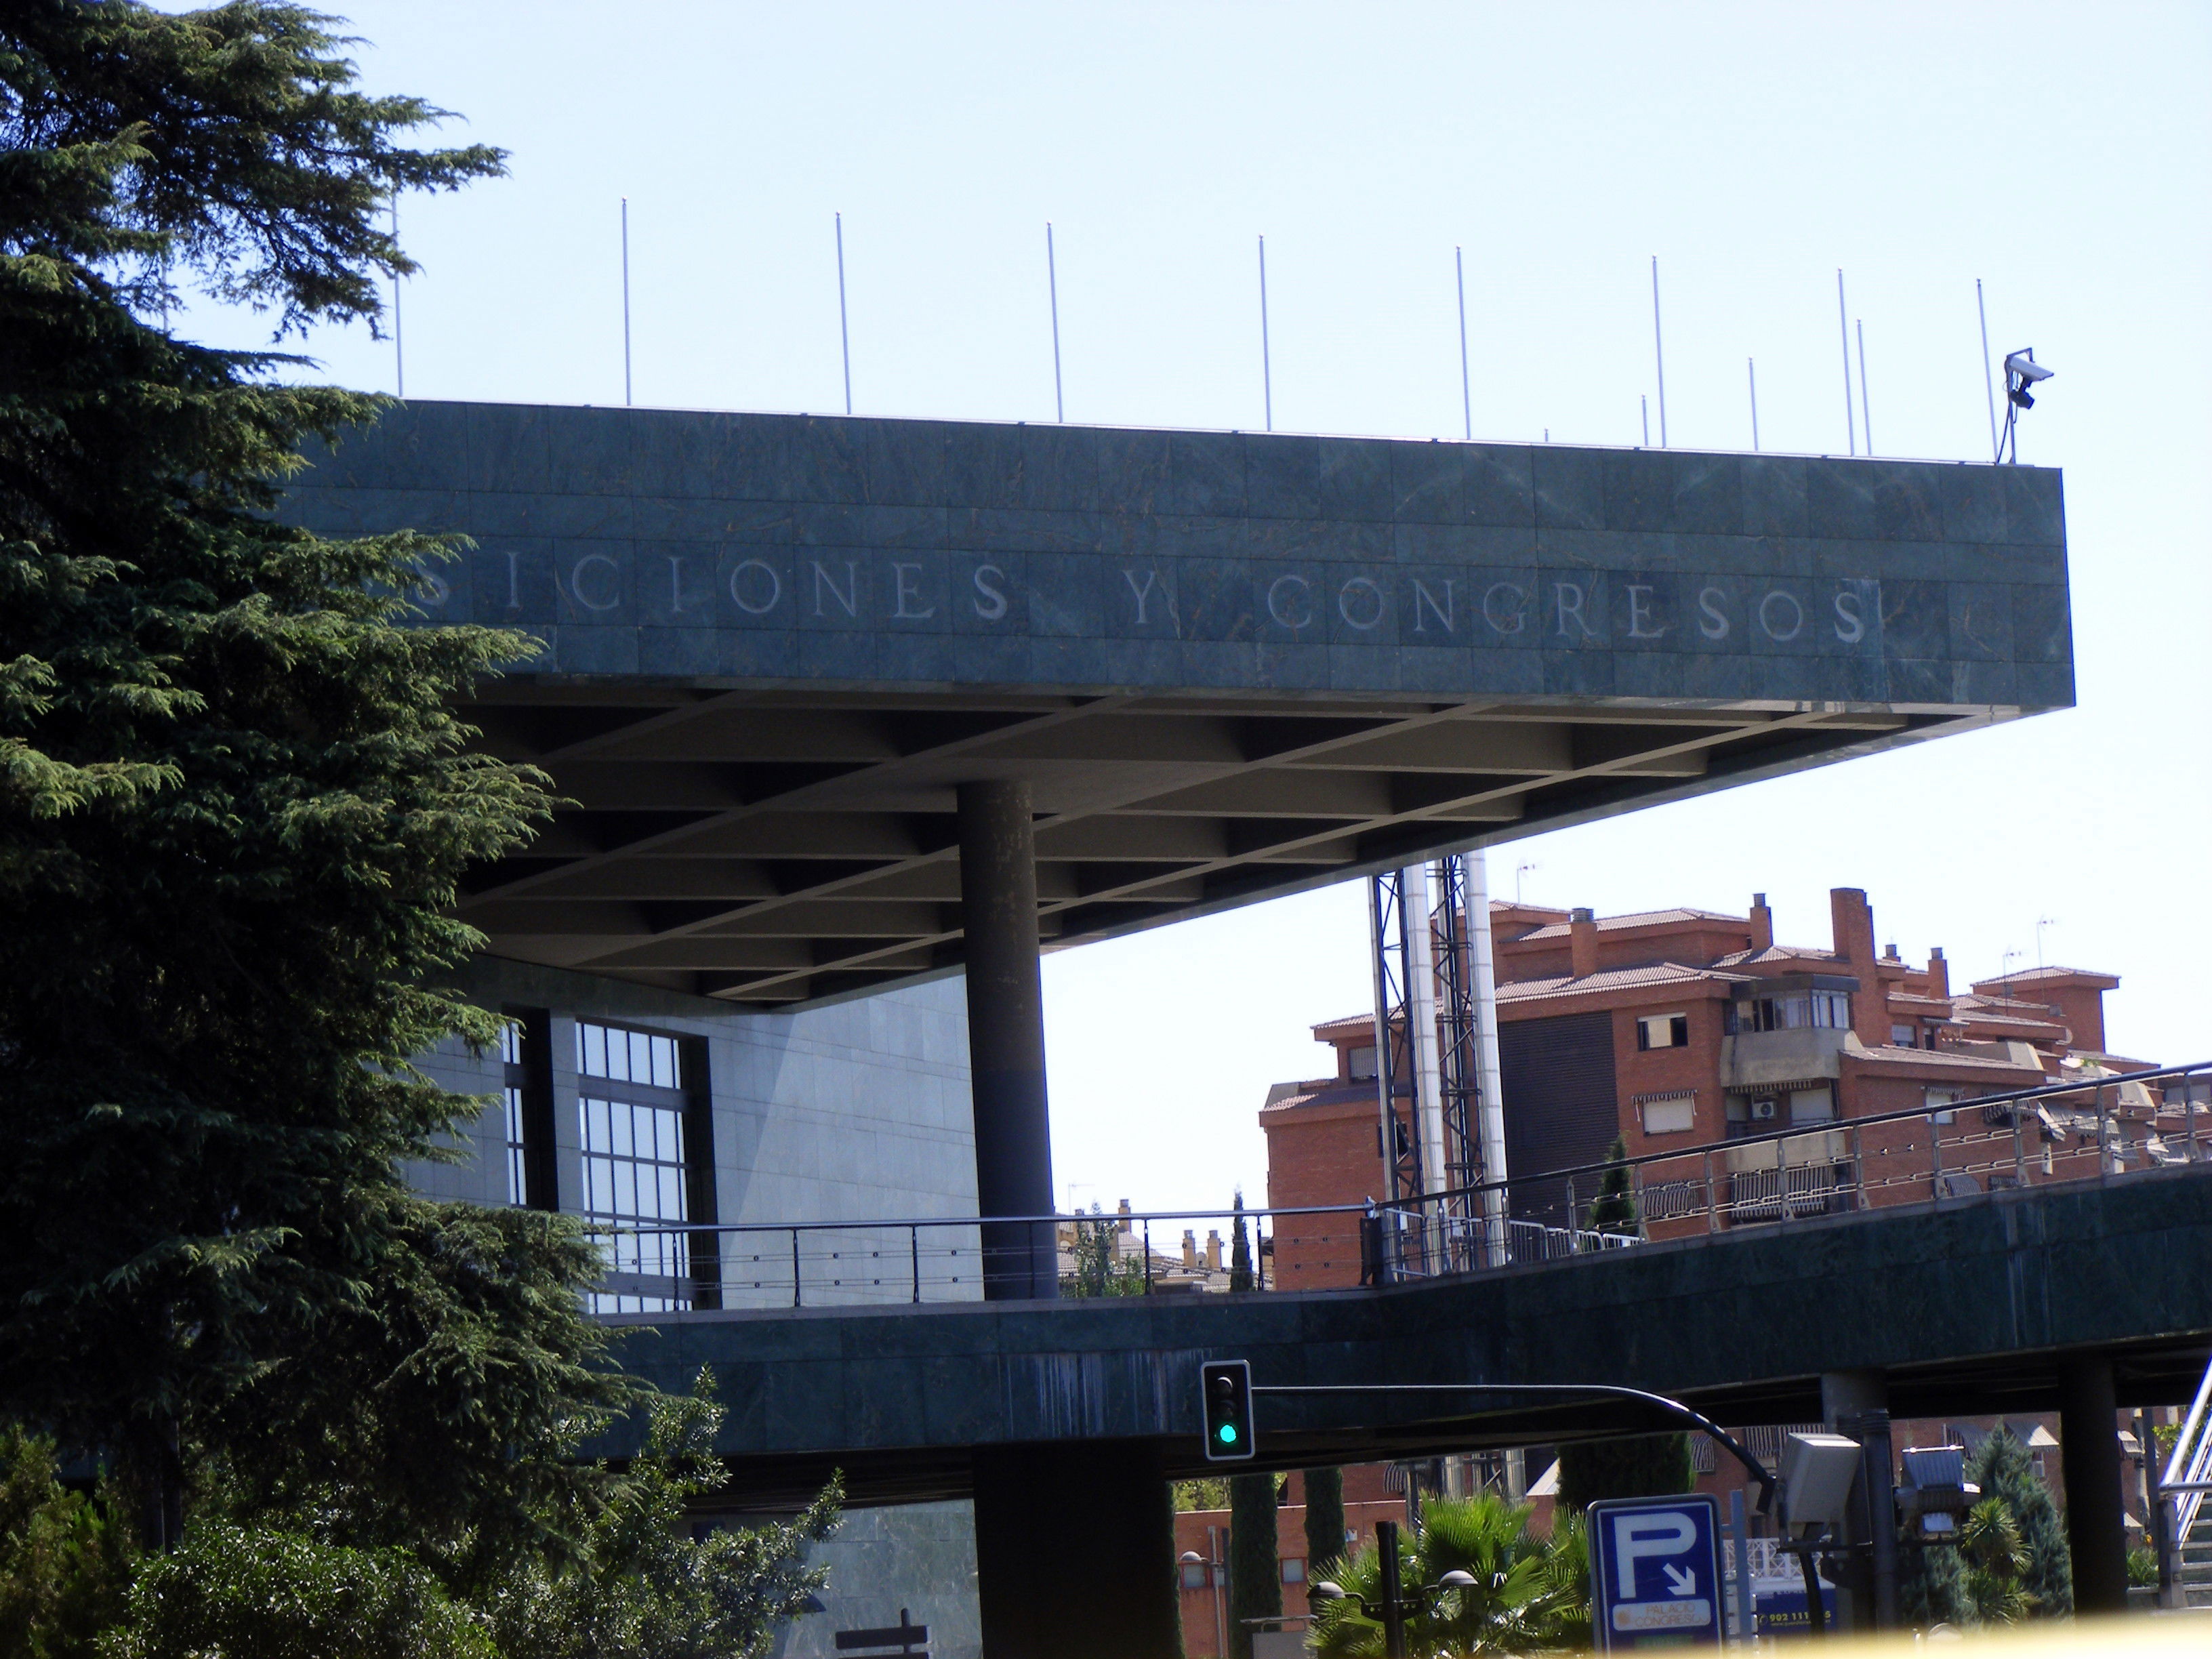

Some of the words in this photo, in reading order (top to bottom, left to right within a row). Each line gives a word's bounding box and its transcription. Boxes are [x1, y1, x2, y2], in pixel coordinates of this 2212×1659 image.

[322, 548, 1008, 622] SICIONES
[1122, 569, 1155, 624] Y
[1267, 574, 1865, 643] CONGRESOS
[1614, 1511, 1697, 1599] P
[1645, 1603, 1696, 1615] PALACIO
[1769, 1613, 1788, 1622] 902
